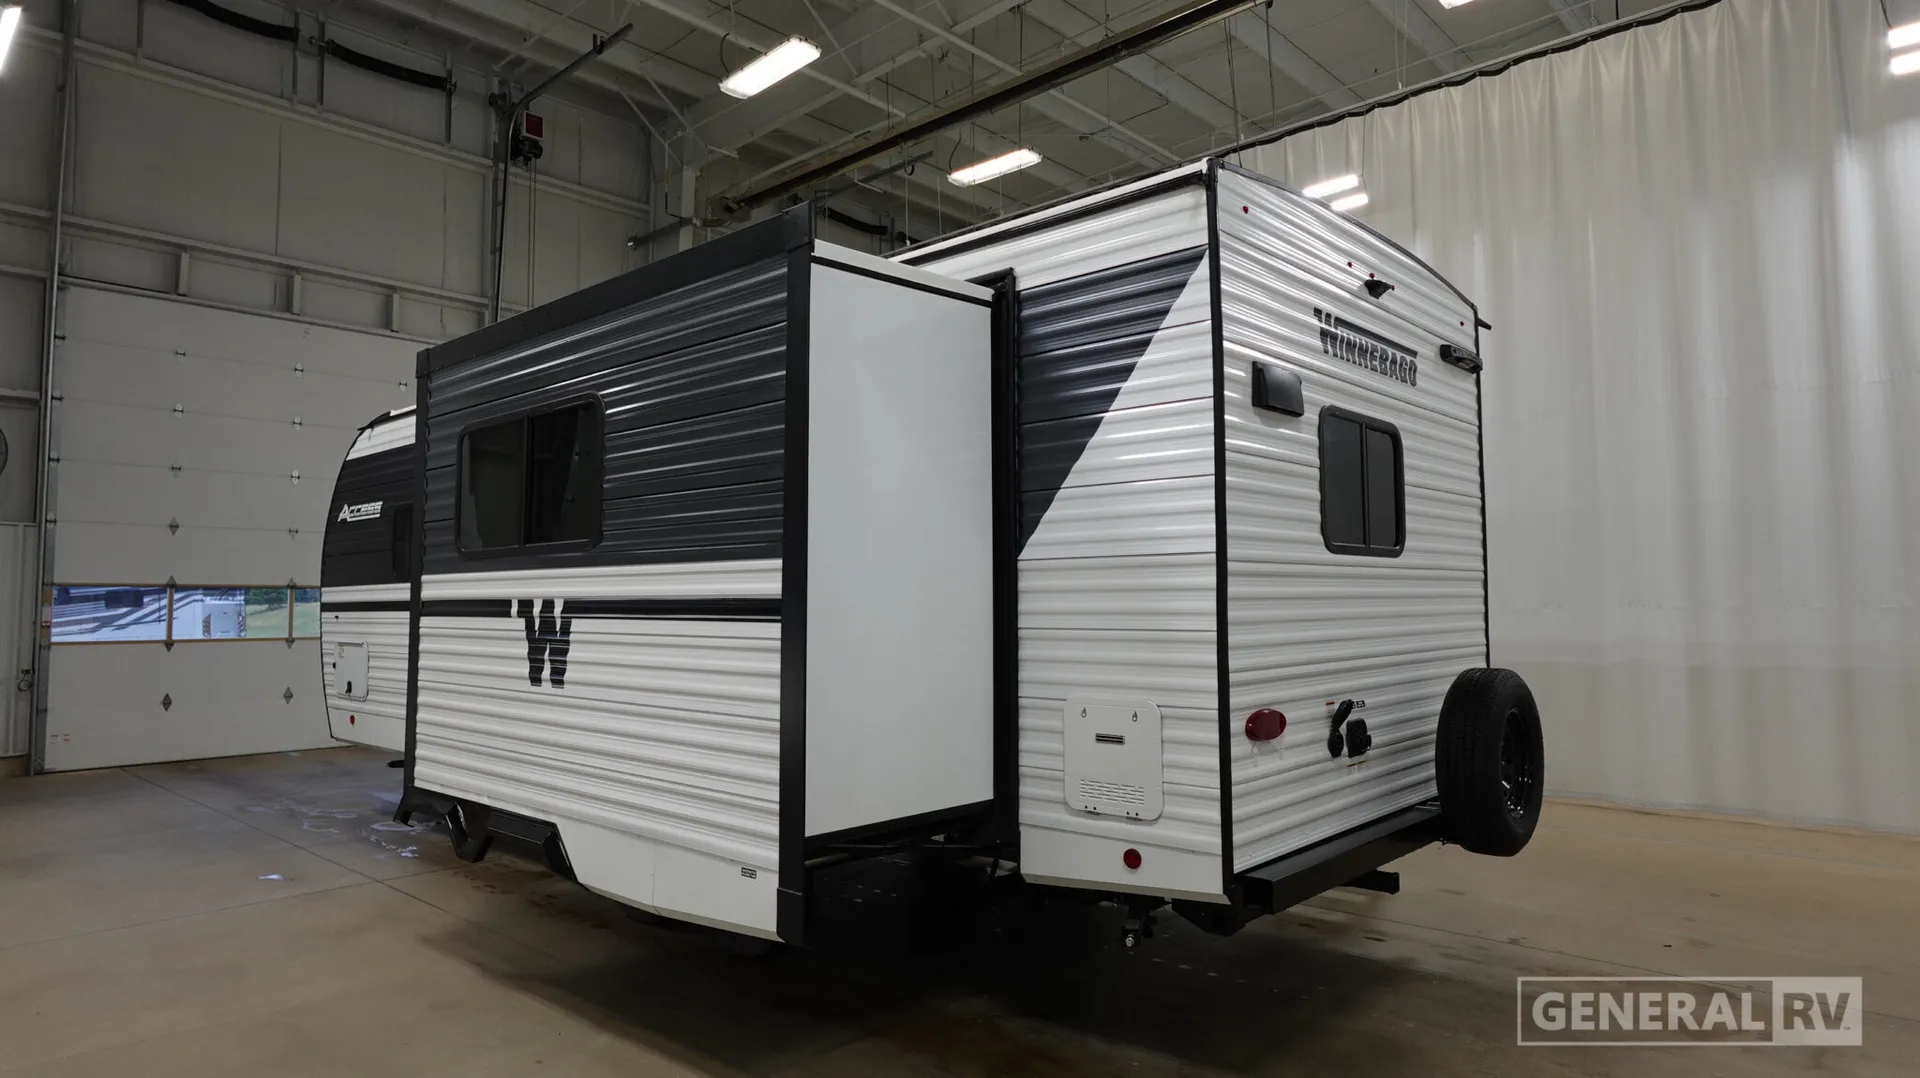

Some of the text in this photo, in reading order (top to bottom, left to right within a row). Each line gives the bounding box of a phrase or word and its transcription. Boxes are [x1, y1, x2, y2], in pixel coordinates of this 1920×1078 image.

[1313, 307, 1418, 387] WINNEBAGO
[337, 501, 383, 521] ACCESS
[516, 598, 573, 689] W
